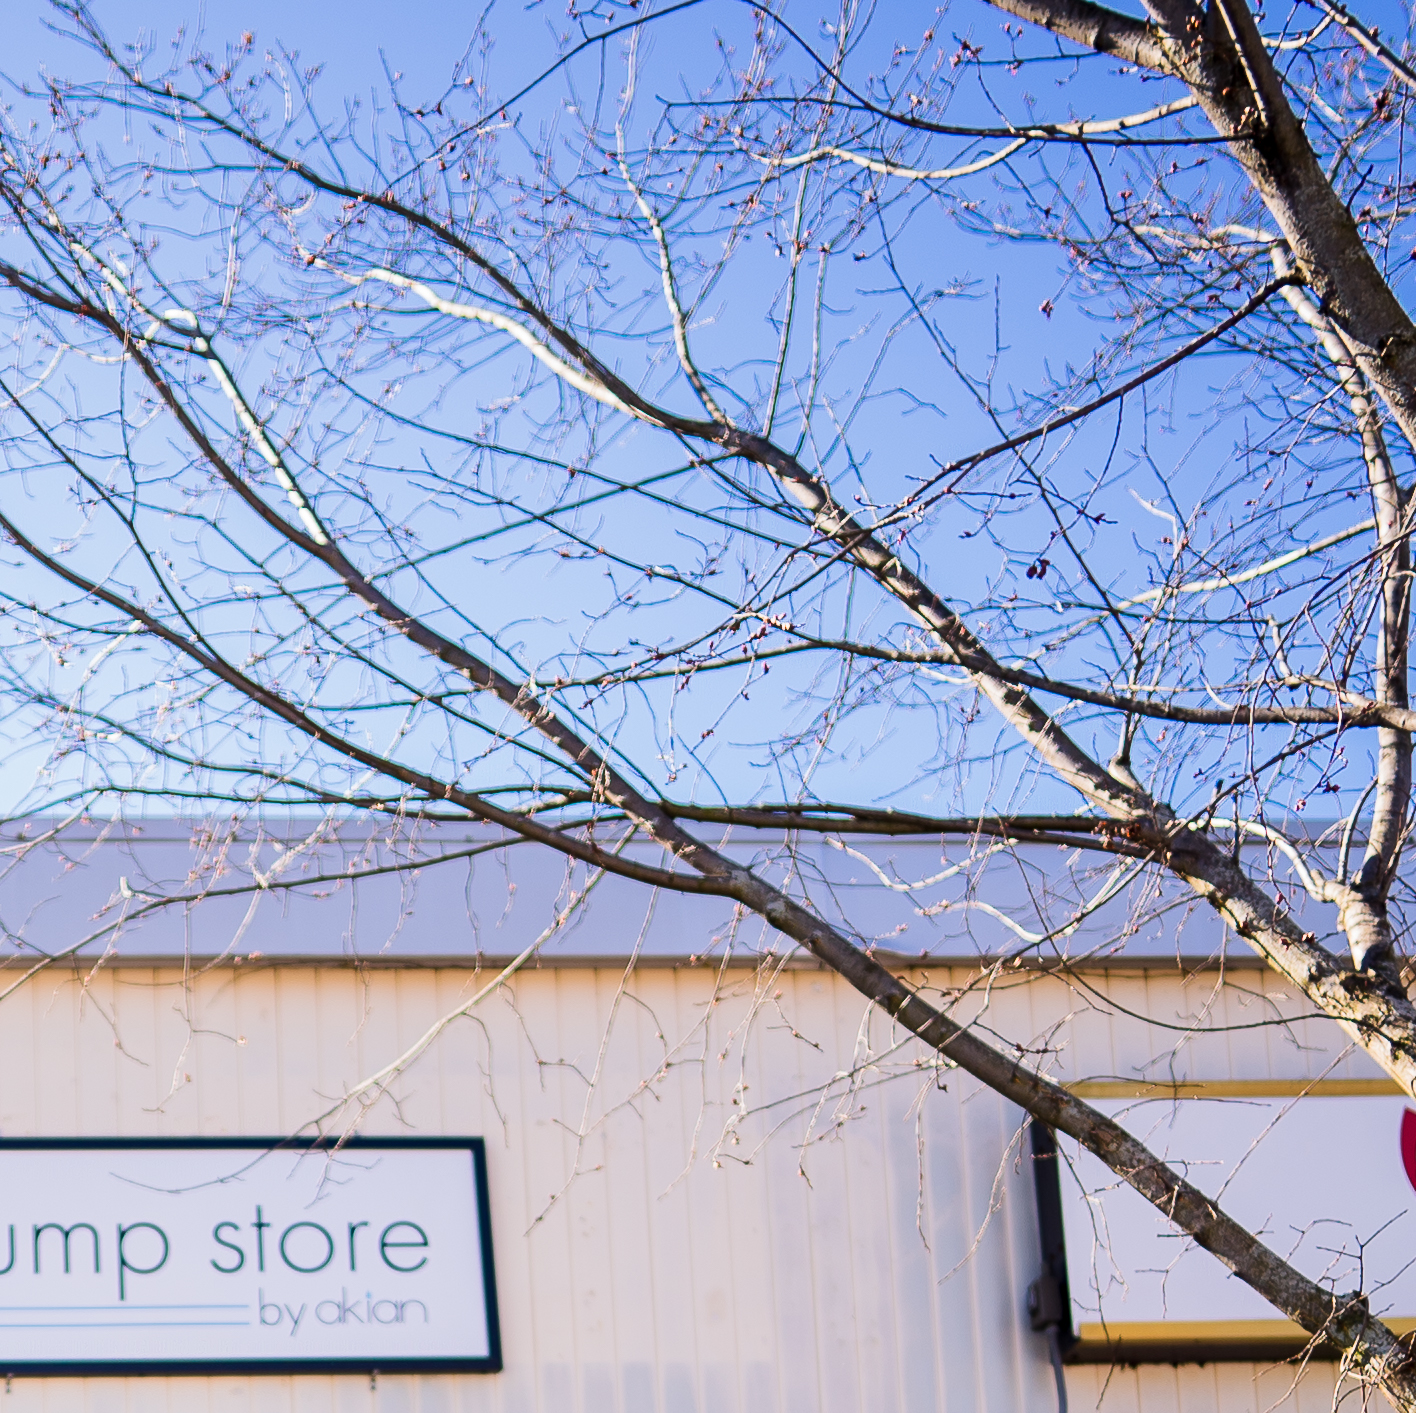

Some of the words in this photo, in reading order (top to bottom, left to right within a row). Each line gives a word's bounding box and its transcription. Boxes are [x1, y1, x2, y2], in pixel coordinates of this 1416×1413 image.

[210, 1205, 430, 1275] store
[258, 1286, 306, 1337] by
[315, 1286, 428, 1326] akian
